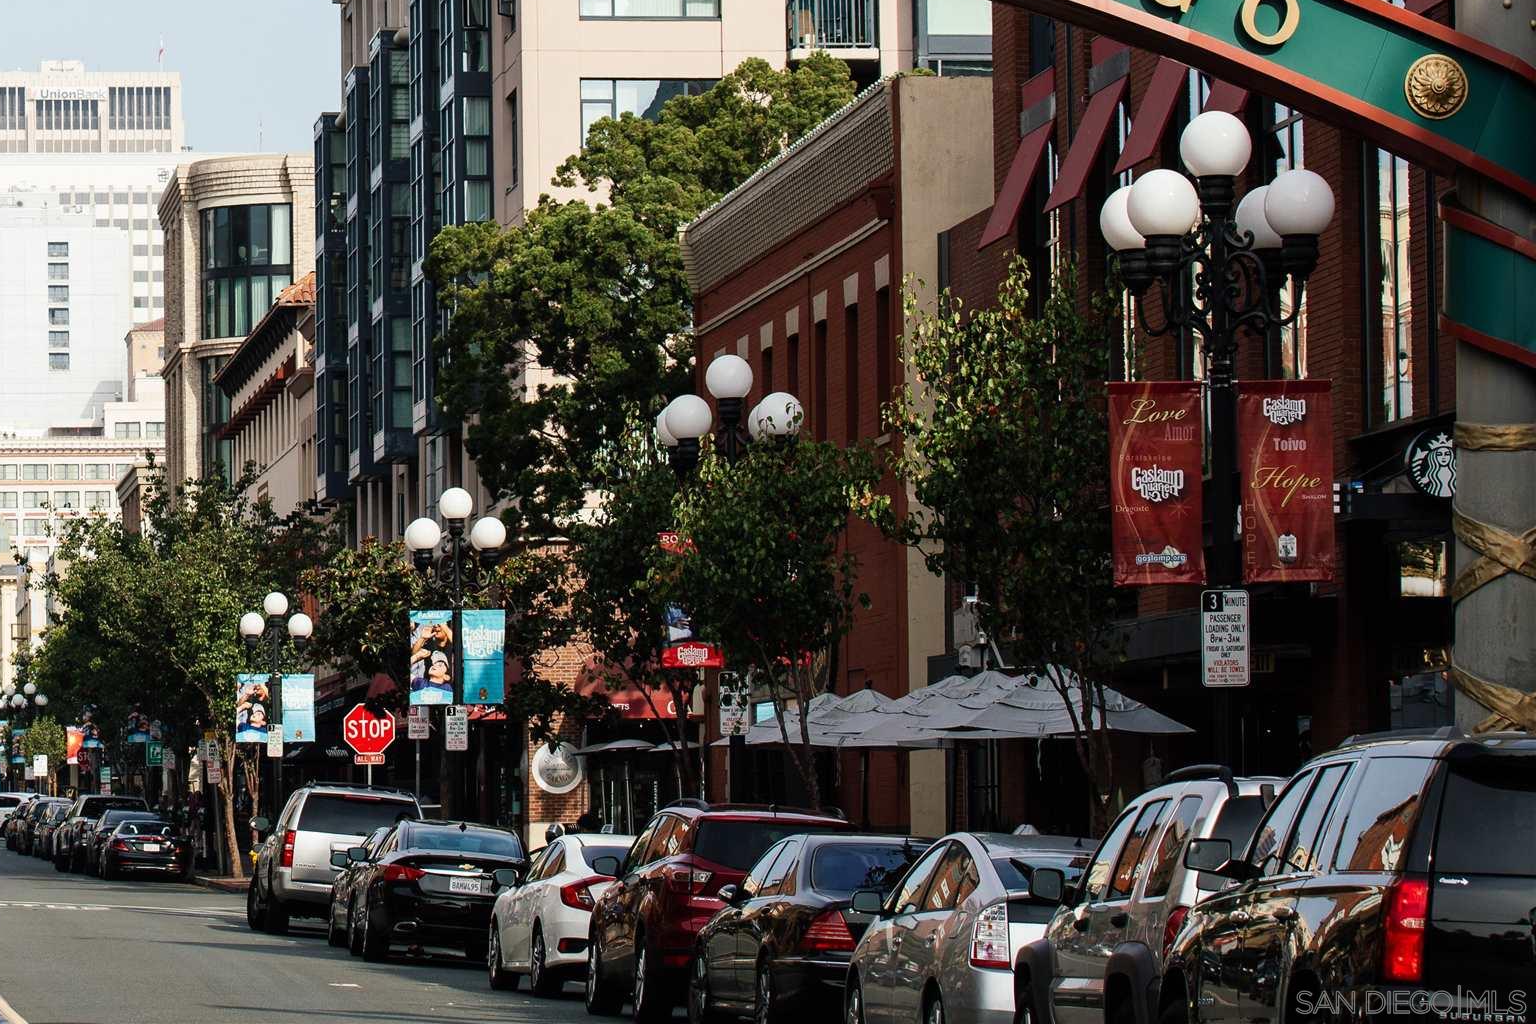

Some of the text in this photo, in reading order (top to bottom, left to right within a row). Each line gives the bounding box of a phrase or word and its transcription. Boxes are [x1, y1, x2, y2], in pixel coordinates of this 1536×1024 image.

[40, 88, 107, 99] UnionBank
[1123, 399, 1186, 425] Love
[1263, 395, 1306, 417] Gaslamp
[1165, 424, 1194, 441] Amor
[1273, 438, 1307, 451] Toivo
[1131, 464, 1184, 491] Gaslamp
[1141, 481, 1180, 502] Quarter
[1250, 465, 1322, 508] Hope
[1210, 594, 1247, 610] 3 MINUTE
[1210, 614, 1241, 623] PASSENGER
[1206, 624, 1245, 633] LOADING ONLY
[347, 719, 392, 739] STOP
[1439, 1012, 1527, 1023] SUBURBAN
